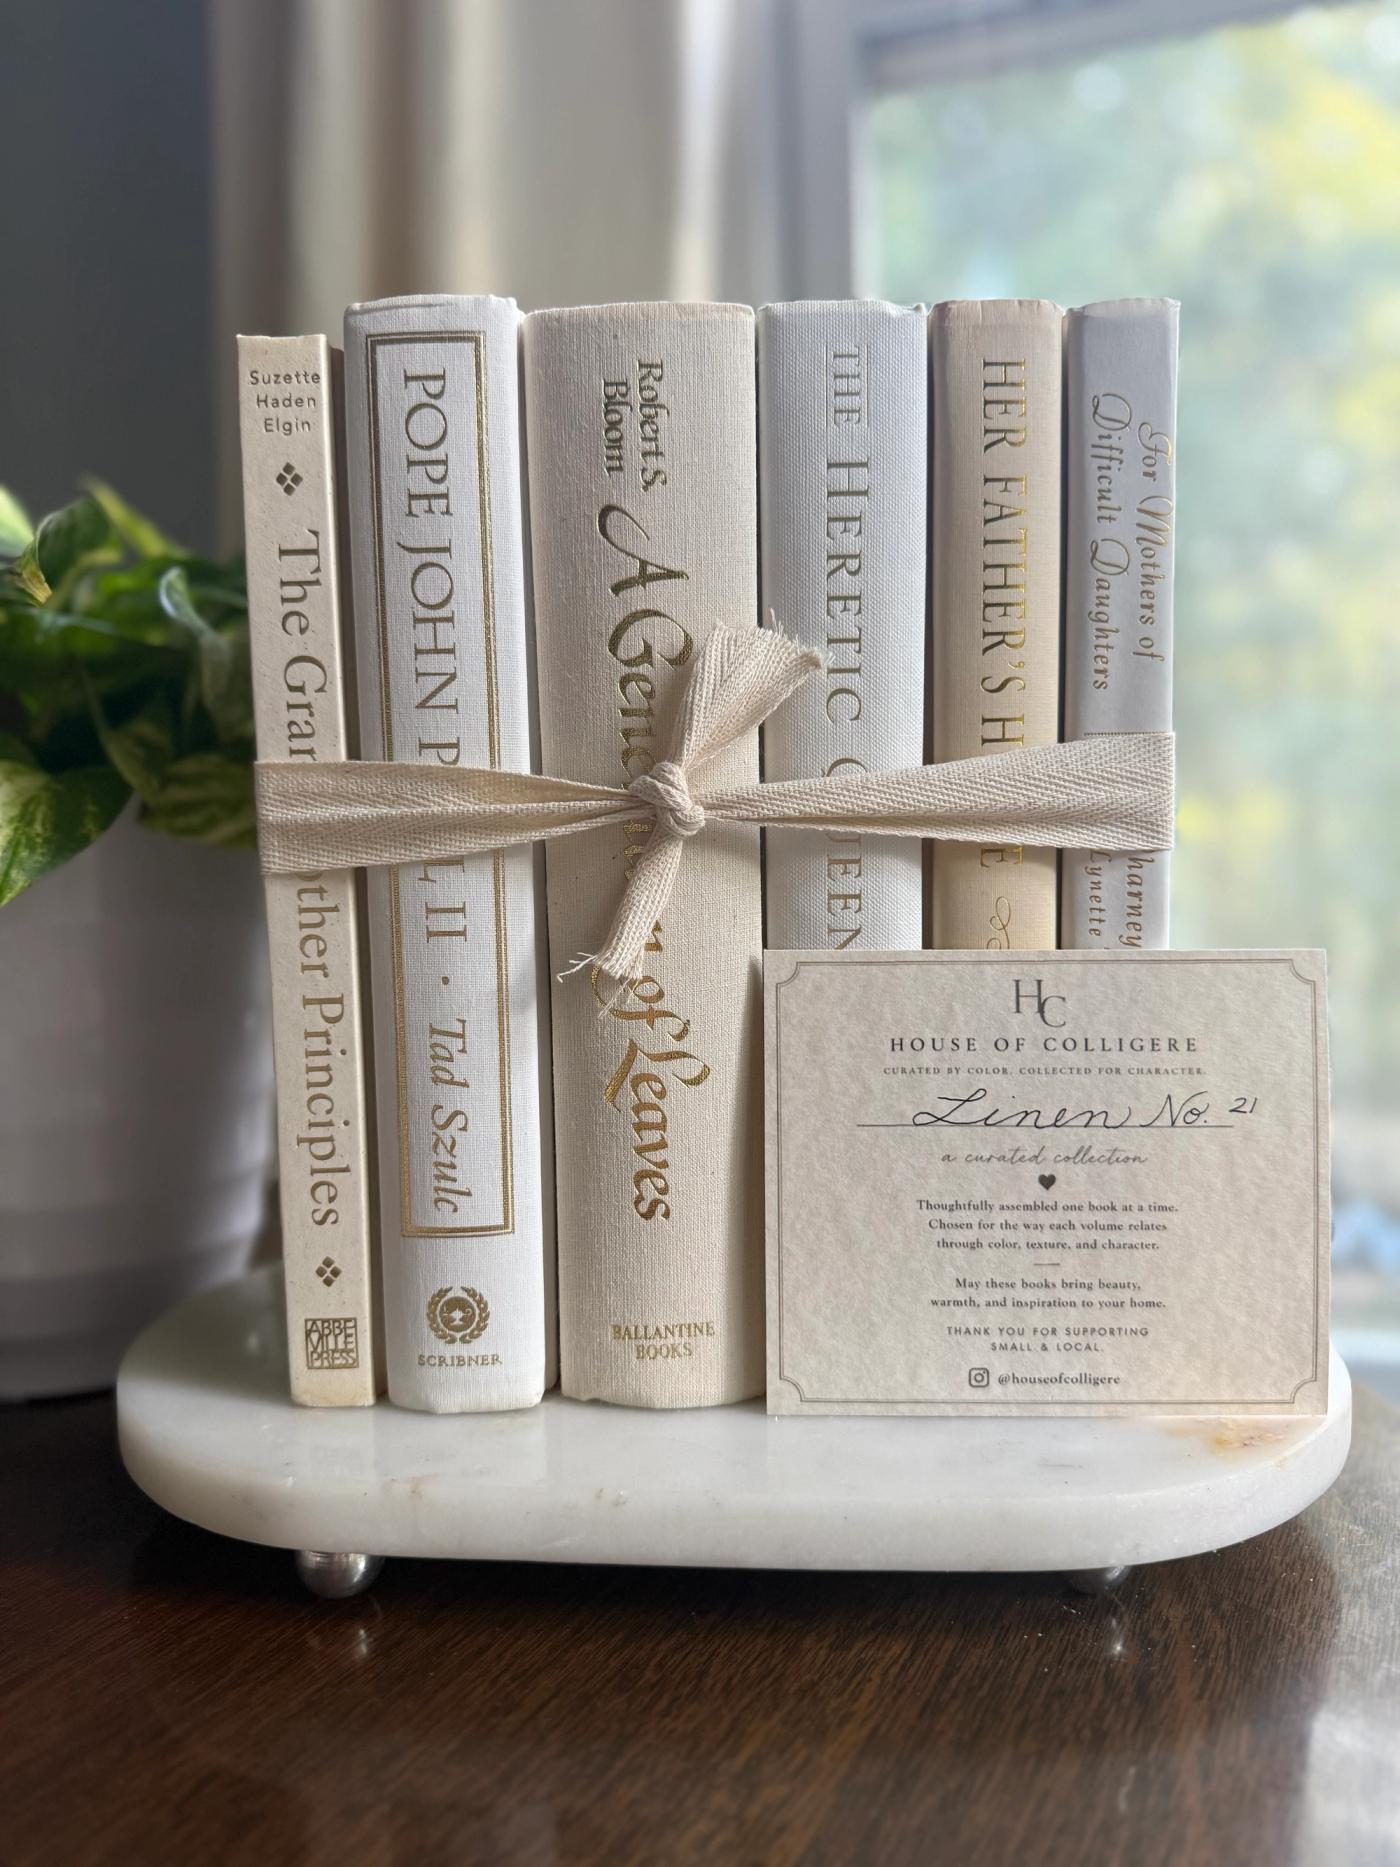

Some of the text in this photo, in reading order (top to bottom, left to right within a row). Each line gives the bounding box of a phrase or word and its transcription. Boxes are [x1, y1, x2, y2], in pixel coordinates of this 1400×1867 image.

[249, 370, 321, 385] Suzette
[832, 345, 863, 428] THE
[256, 393, 317, 408] Haden
[638, 359, 670, 463] Robert
[981, 357, 1027, 453] HER
[263, 416, 312, 436] Elgin
[403, 368, 454, 518] POPE
[602, 378, 633, 478] Bloom
[597, 503, 690, 598] A
[1087, 393, 1132, 692] Difficult Daughters
[1132, 421, 1174, 663] For Mothers of
[277, 528, 323, 637] The
[826, 457, 869, 726] HERETIC
[981, 475, 1028, 694] FATHER'S
[396, 539, 459, 715] JOHN
[1118, 849, 1156, 949] harney
[425, 901, 468, 943] II
[591, 964, 691, 1042] of
[1013, 979, 1067, 1028] HC
[428, 1018, 469, 1089] Tad
[890, 1037, 1198, 1052] HOUSE OF COLLIGERE
[883, 1066, 941, 1076] CURATED
[946, 1066, 961, 1076] BY
[1018, 1067, 1092, 1076] COLLECTED
[1098, 1067, 1121, 1076] FOR
[295, 993, 352, 1227] Principles
[912, 1088, 1258, 1129] Linen No. 21
[603, 1038, 711, 1222] Leaves
[429, 1104, 474, 1214] Szulc
[941, 1144, 1148, 1165] a curated collection
[917, 1199, 1179, 1213] Thoughtfully assembled one book at a time.
[928, 1218, 1168, 1232] Chosen for the way each volume relates
[936, 1238, 1160, 1251] through color, texture, and character.
[930, 1296, 1166, 1310] warmth, and inspiration to your home.
[955, 1277, 1141, 1291] May these books bring beauty,
[305, 1319, 356, 1336] ABBE
[305, 1333, 356, 1351] VILLE
[611, 1321, 716, 1341] BALLANTINE
[947, 1326, 1149, 1337] THANK YOU FOR SUPPORTING
[991, 1342, 1105, 1352] SMALL & LOCAL.
[309, 1349, 358, 1369] PRESS
[417, 1353, 503, 1368] SCRIBNER
[635, 1342, 694, 1360] BOOKS
[998, 1371, 1121, 1387] @houseofcolligere
